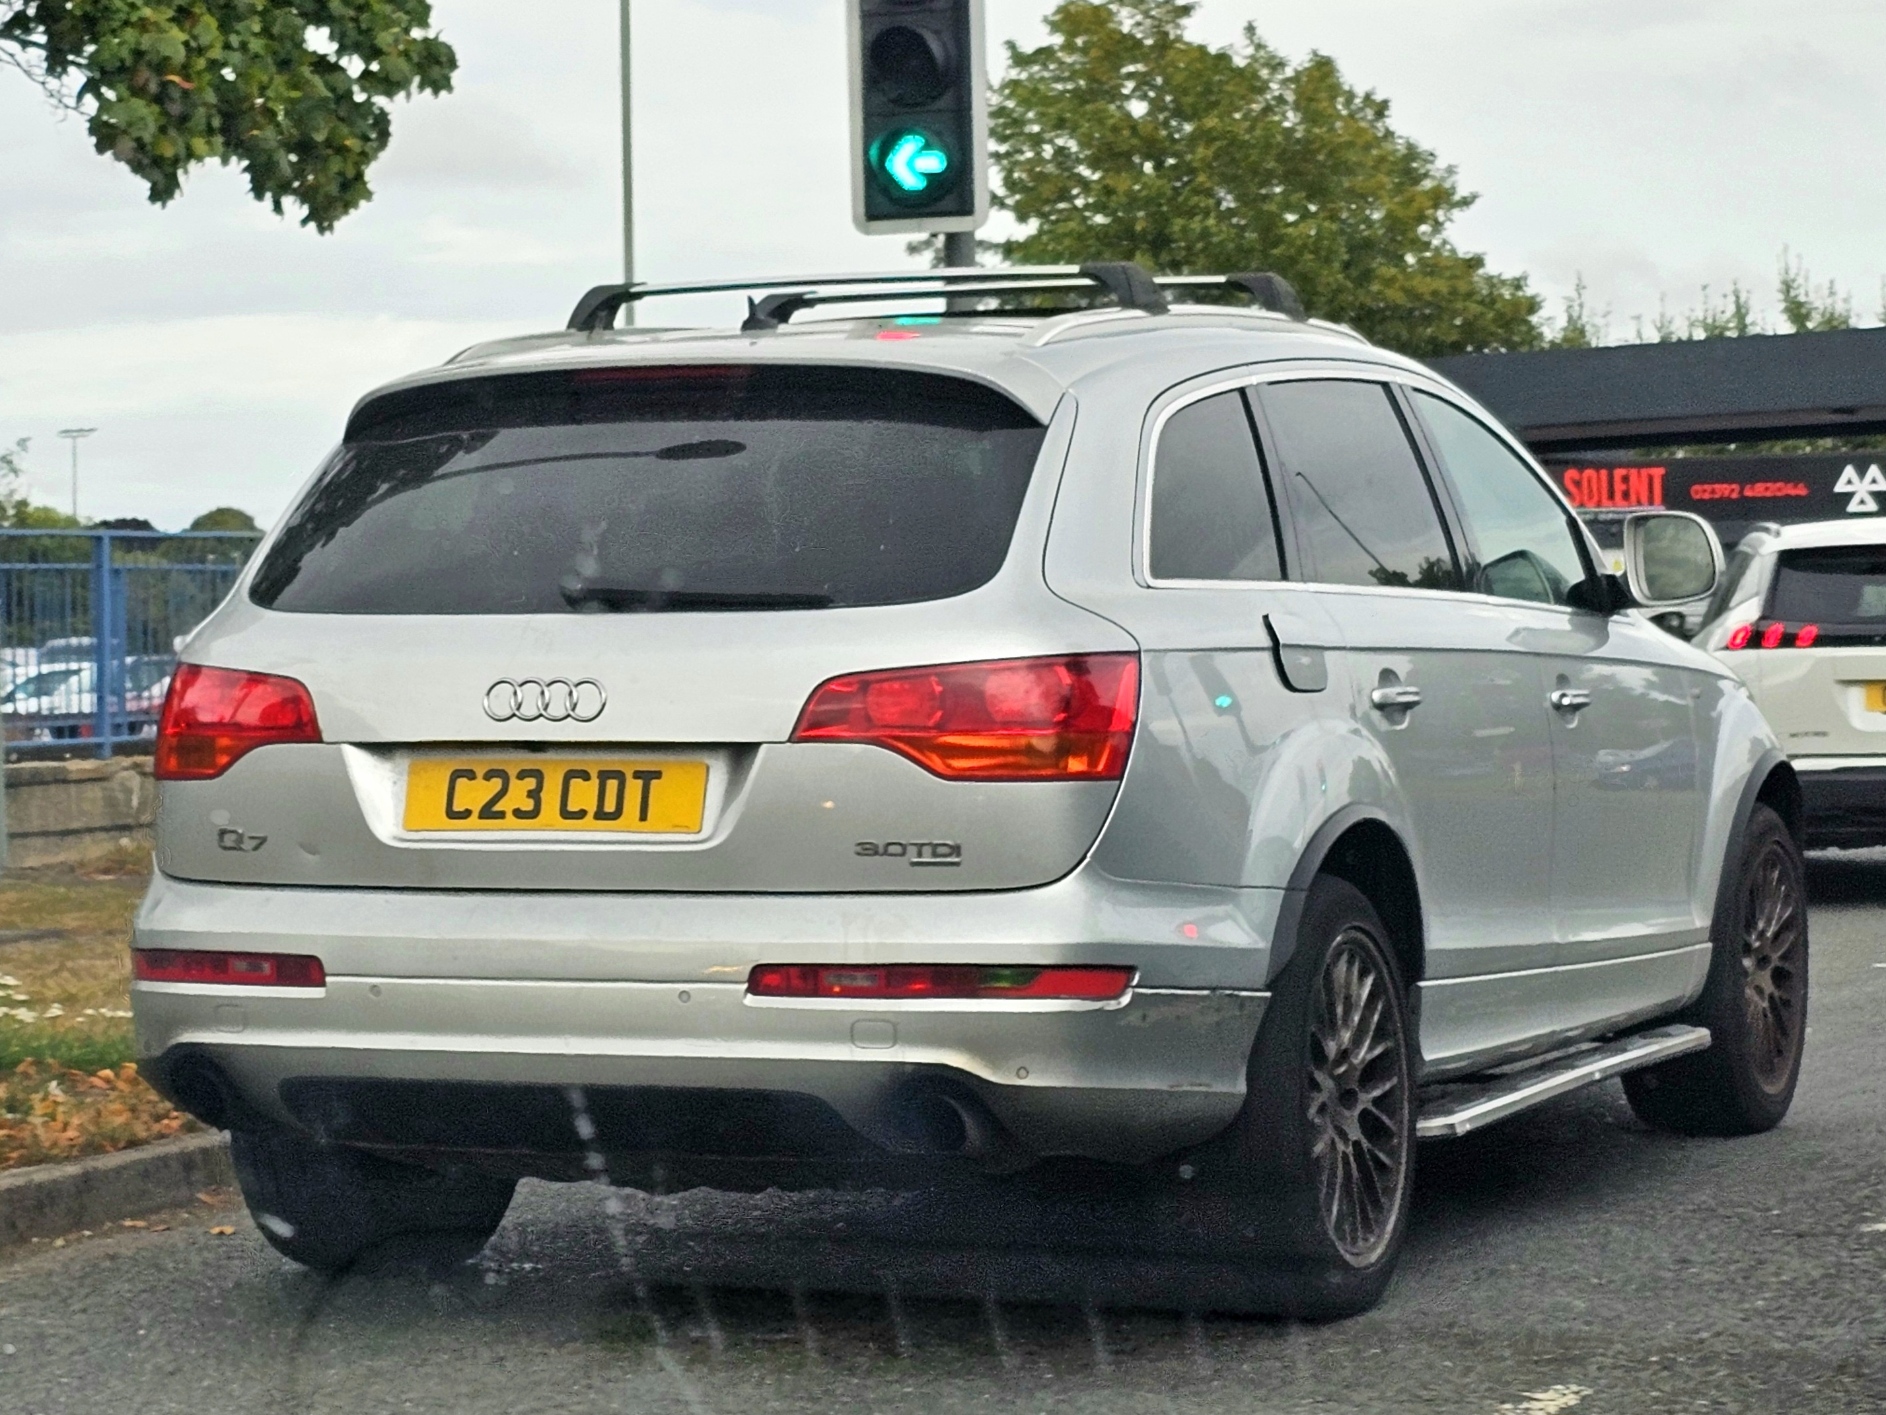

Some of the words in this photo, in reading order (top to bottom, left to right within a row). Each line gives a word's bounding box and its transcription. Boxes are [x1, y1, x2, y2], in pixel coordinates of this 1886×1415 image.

[1564, 466, 1665, 508] SOLENT
[1690, 483, 1740, 500] 02392
[446, 769, 544, 820] C23
[560, 769, 662, 821] CDT
[218, 828, 268, 852] Q7
